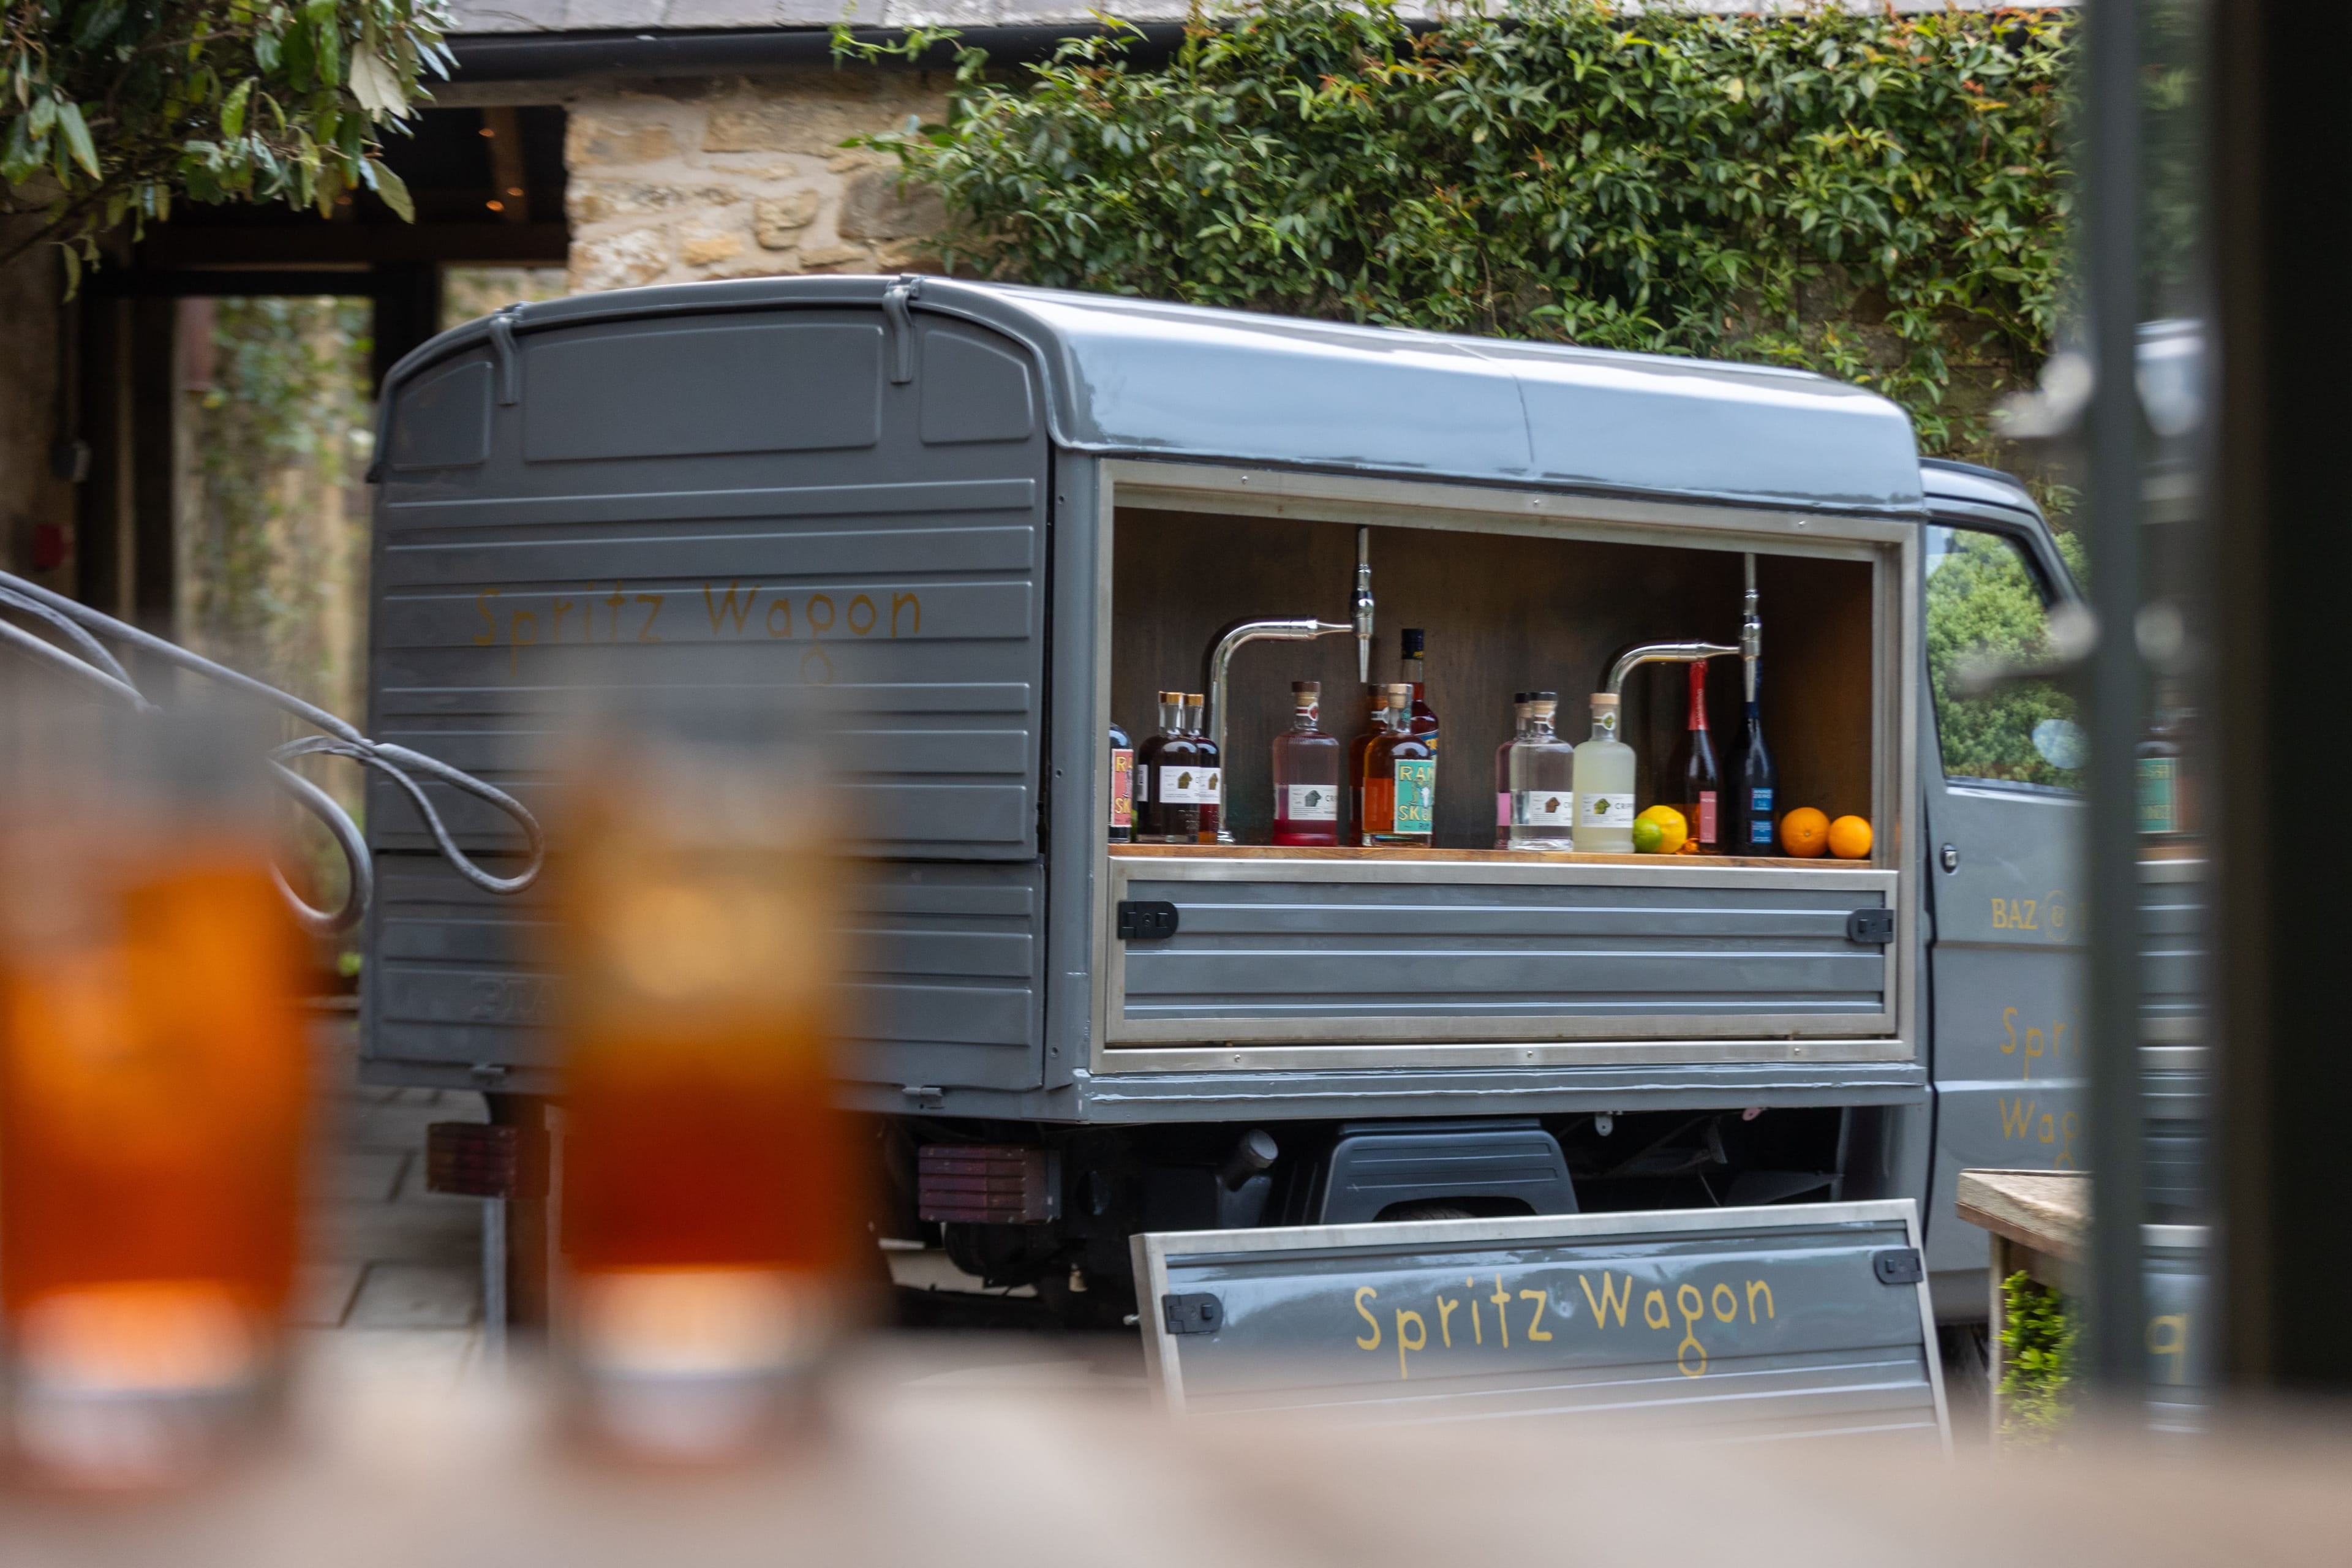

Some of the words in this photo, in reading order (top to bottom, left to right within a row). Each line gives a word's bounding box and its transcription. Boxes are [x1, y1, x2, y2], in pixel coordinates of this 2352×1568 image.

[472, 579, 663, 677] Spritz
[704, 579, 921, 685] Wagon
[1991, 898, 2038, 930] BAZ
[1354, 1273, 1553, 1379] Spritz
[1579, 1272, 1775, 1378] Wagon
